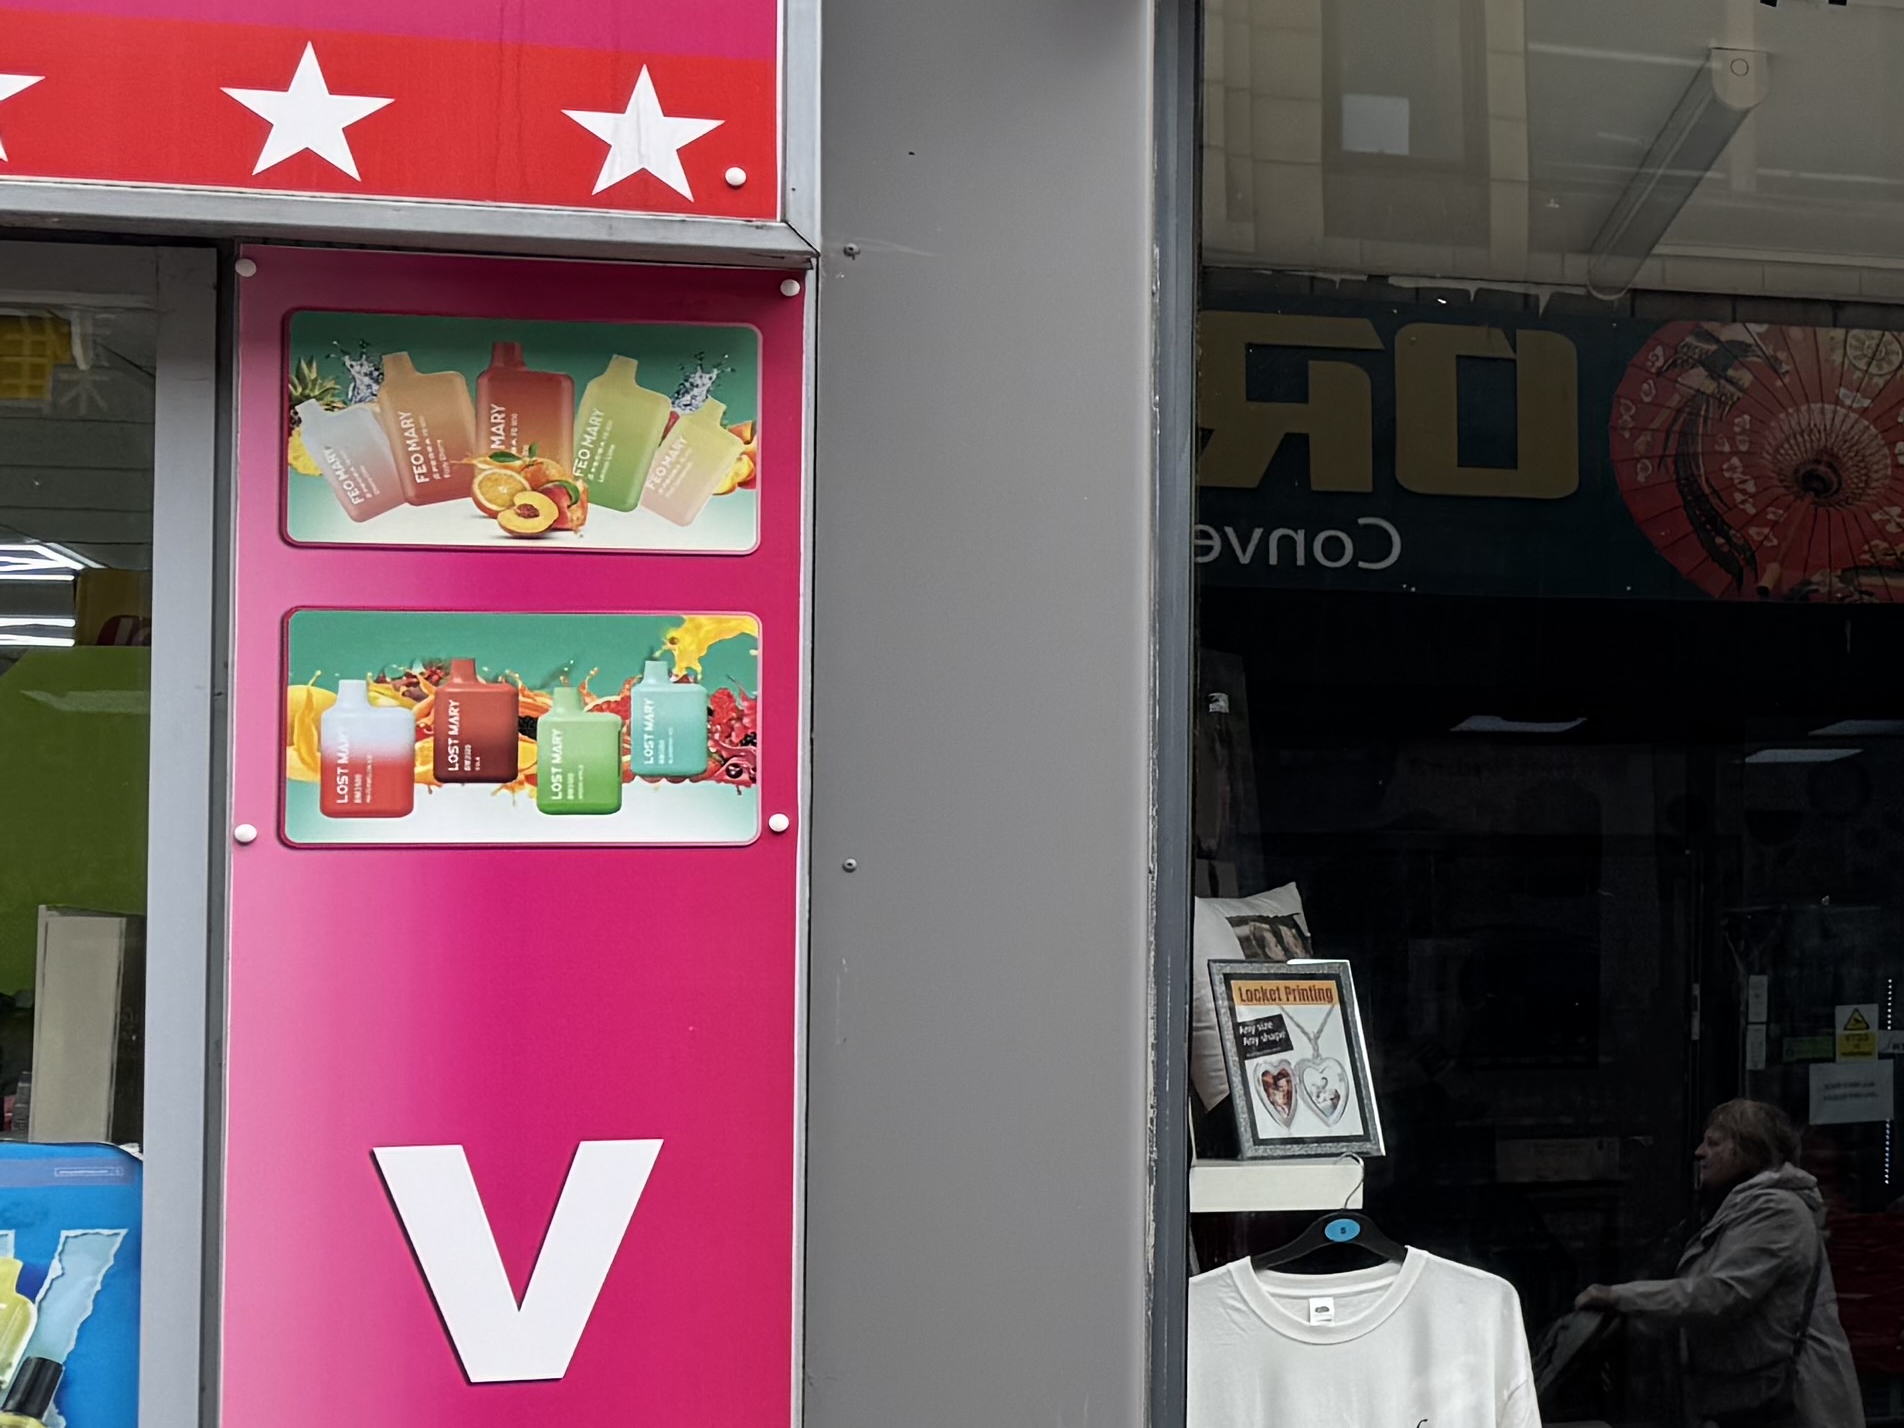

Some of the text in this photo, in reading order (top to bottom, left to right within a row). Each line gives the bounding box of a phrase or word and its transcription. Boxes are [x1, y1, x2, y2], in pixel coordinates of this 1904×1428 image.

[398, 410, 419, 447] MARY
[490, 403, 507, 453] MARY
[447, 699, 460, 771] LOST MARY
[550, 728, 562, 800] LOST MARY
[1238, 984, 1335, 1004] Locket Printing
